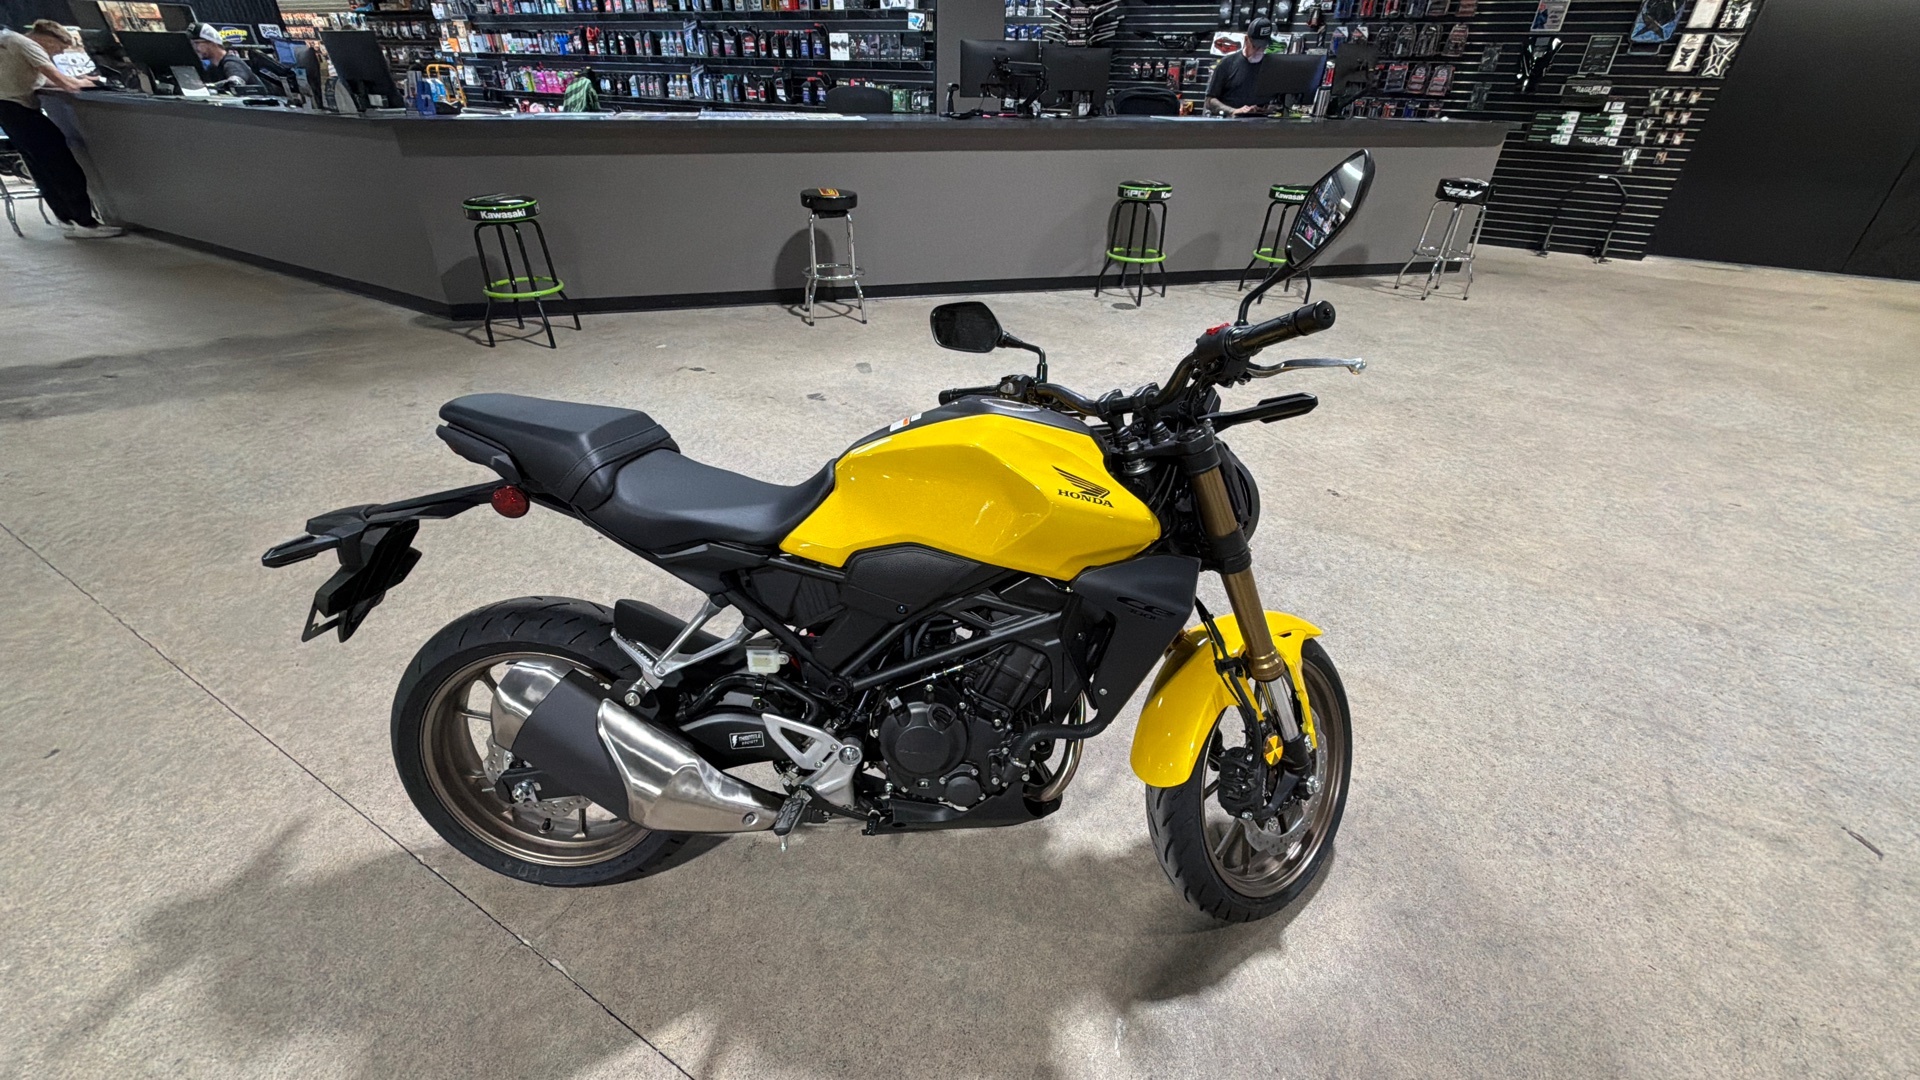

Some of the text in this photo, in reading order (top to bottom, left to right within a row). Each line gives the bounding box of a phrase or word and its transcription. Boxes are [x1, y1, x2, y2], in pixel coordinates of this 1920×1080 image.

[1443, 186, 1483, 198] FLY
[479, 208, 526, 219] Kawasaki
[1057, 489, 1114, 508] HONDA
